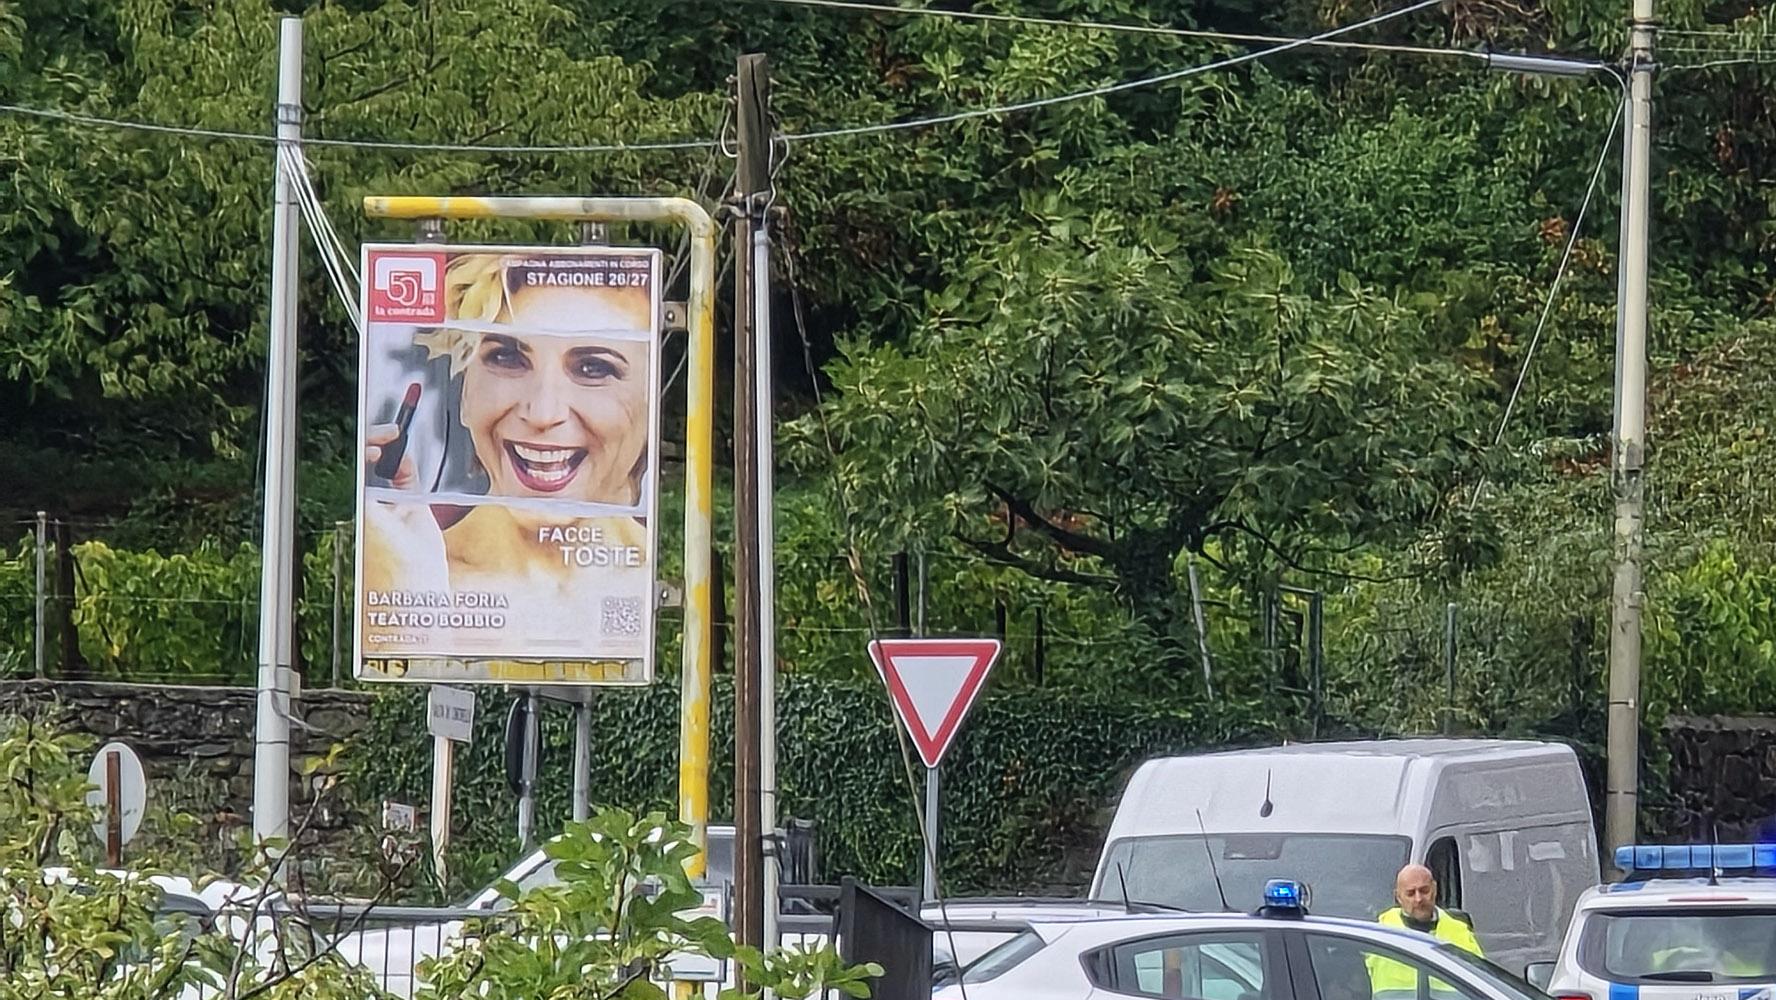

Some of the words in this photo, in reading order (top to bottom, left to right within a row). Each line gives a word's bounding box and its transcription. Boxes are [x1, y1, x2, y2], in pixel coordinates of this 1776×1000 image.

[526, 271, 604, 286] STAGIONE
[608, 272, 649, 287] 26/27
[387, 306, 436, 316] contrada
[538, 526, 602, 543] FACCE
[560, 546, 640, 567] TOSTE
[367, 591, 450, 607] BARBARA
[455, 592, 508, 608] FORIA
[367, 611, 434, 628] TEATRO
[439, 614, 505, 628] BOBBIO
